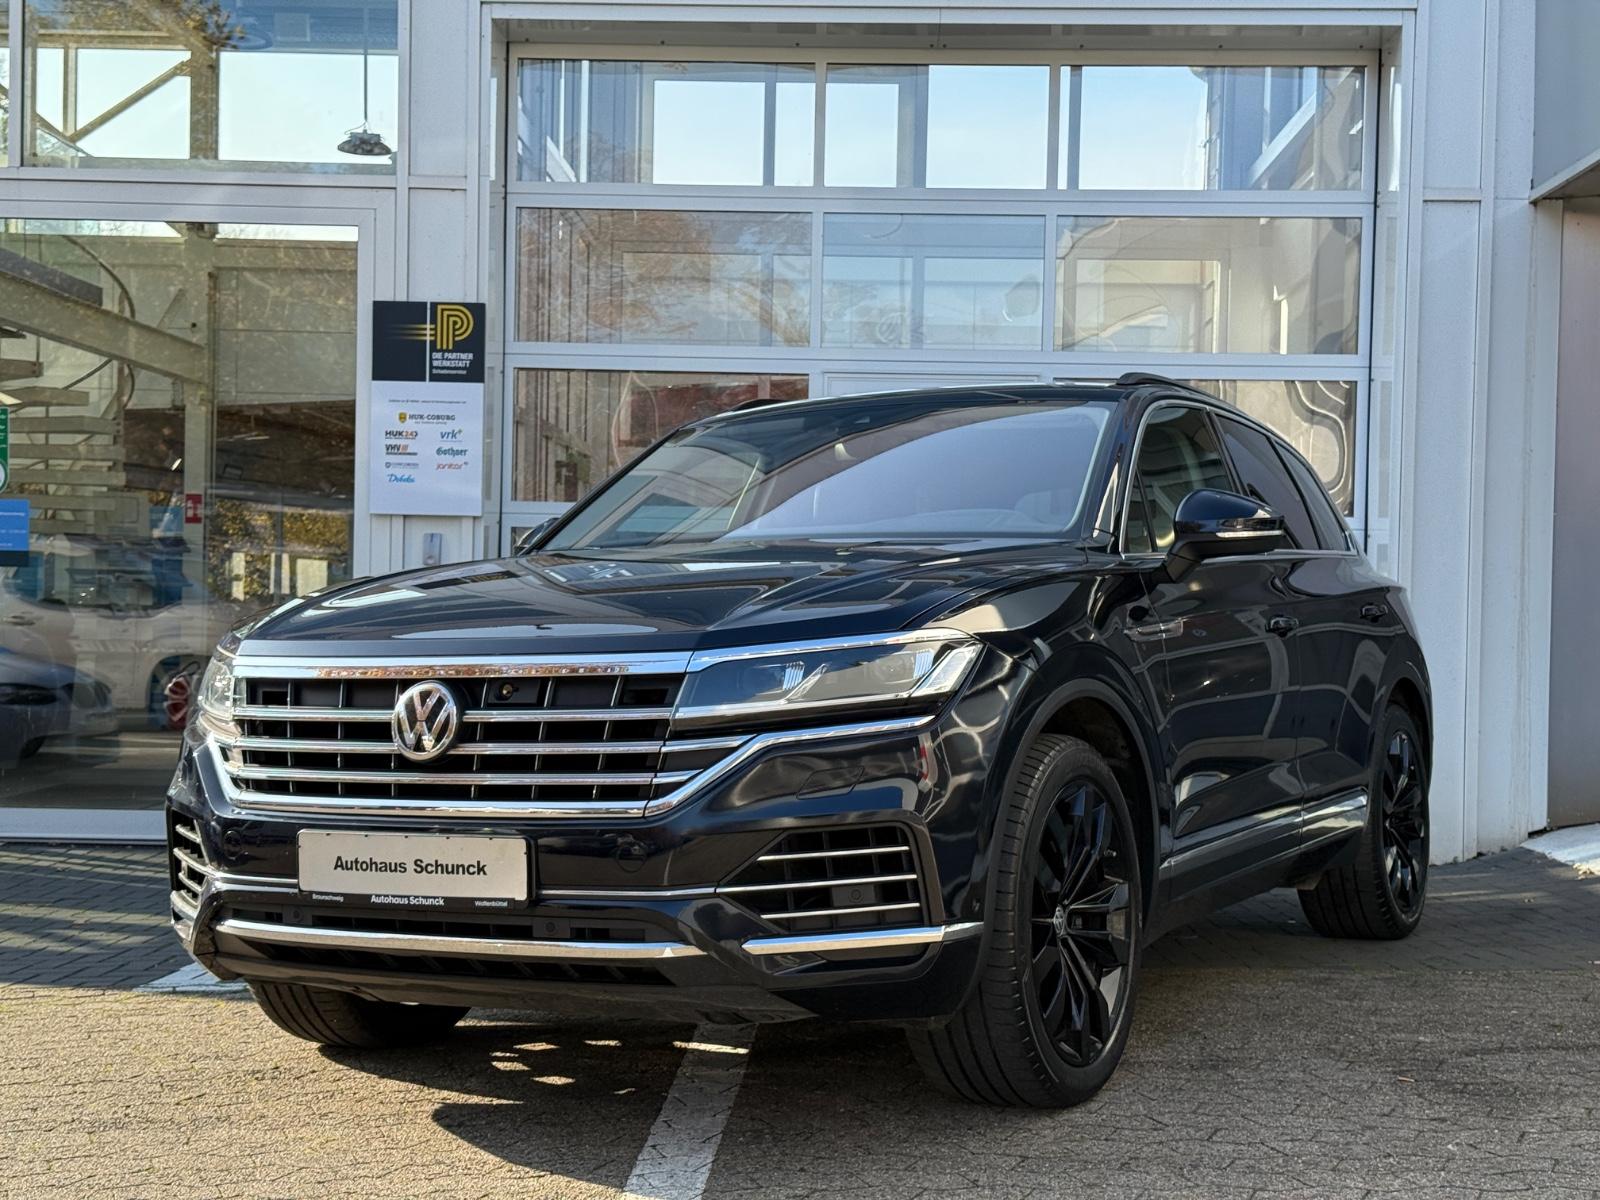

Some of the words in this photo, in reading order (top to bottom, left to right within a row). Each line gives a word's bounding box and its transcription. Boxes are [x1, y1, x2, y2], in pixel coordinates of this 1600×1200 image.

[432, 352, 443, 360] DIE
[444, 352, 474, 361] PARTNER
[432, 360, 471, 368] WERKSTATT
[409, 413, 456, 421] HUK-COBURG
[333, 855, 407, 874] Autohaus
[413, 858, 488, 876] Schunck
[370, 894, 408, 905] Autohaus
[409, 896, 445, 906] Schunck
